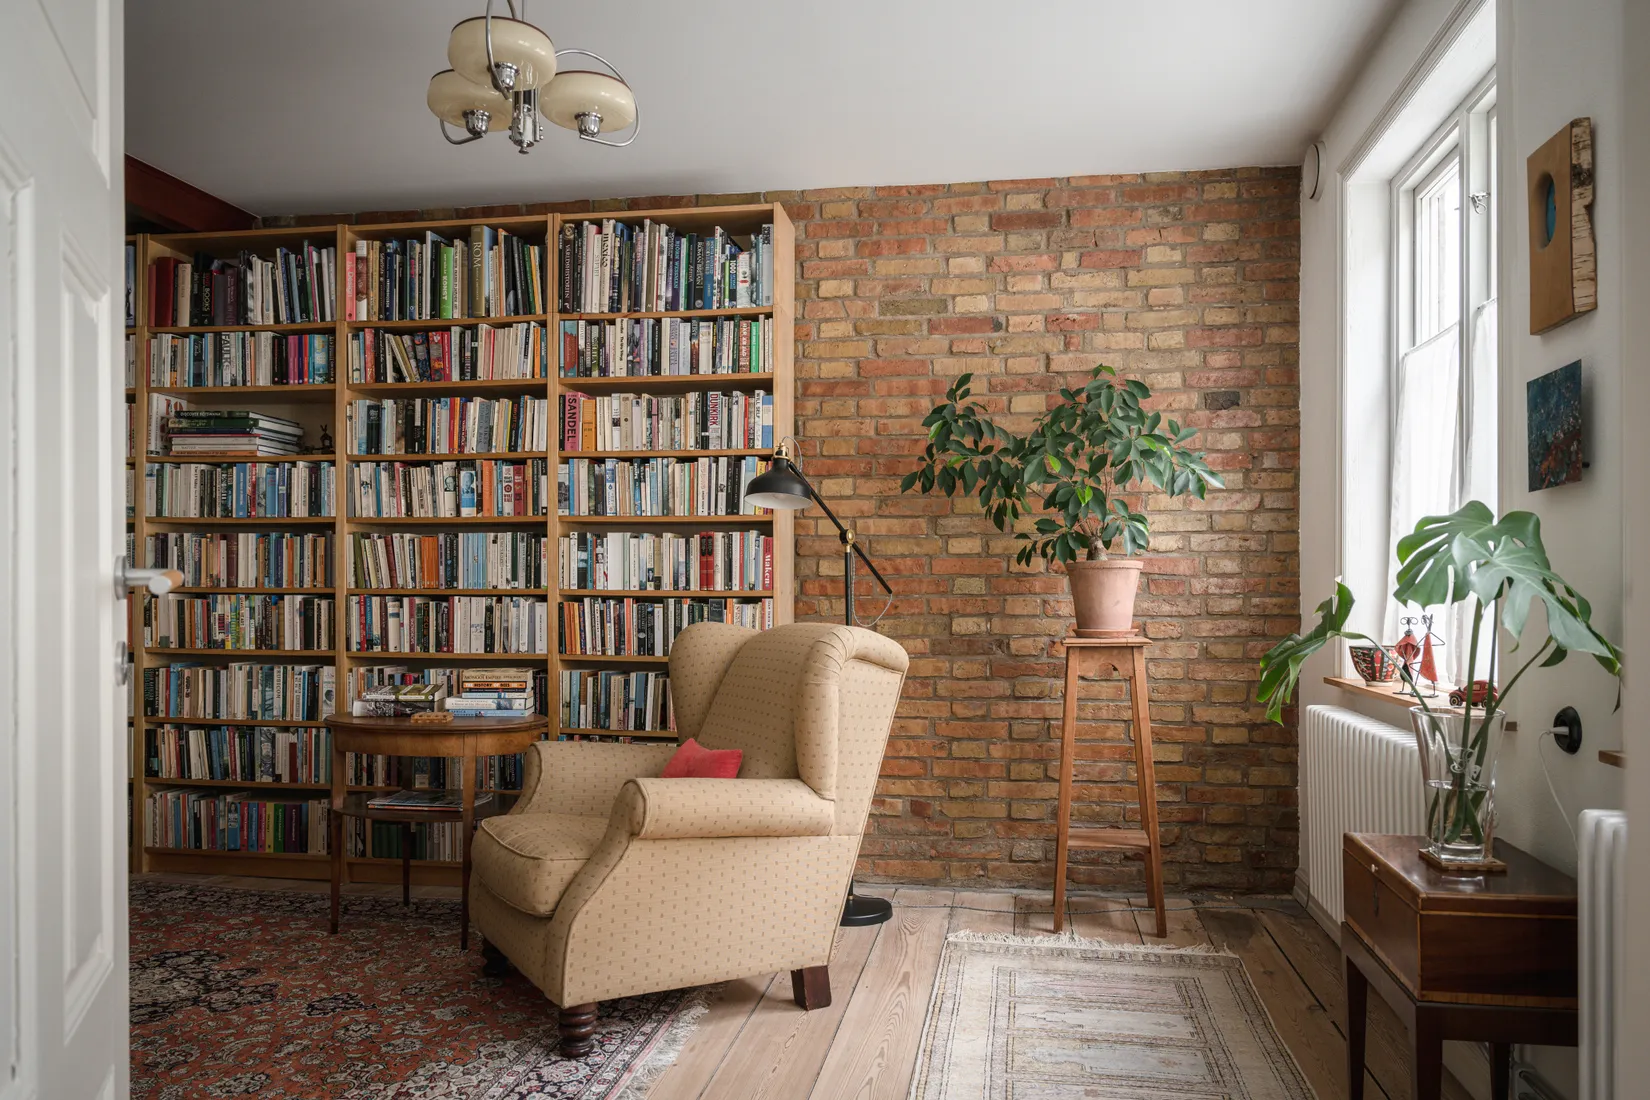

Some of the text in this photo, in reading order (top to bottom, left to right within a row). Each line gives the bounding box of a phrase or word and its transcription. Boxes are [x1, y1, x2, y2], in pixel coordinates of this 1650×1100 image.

[472, 241, 483, 268] ROM
[602, 233, 610, 267] mexico
[346, 272, 354, 297] Design
[221, 334, 231, 371] FAULKS
[567, 397, 577, 442] SANDEL
[709, 393, 719, 426] DUNKIRK
[764, 554, 772, 583] Maken
